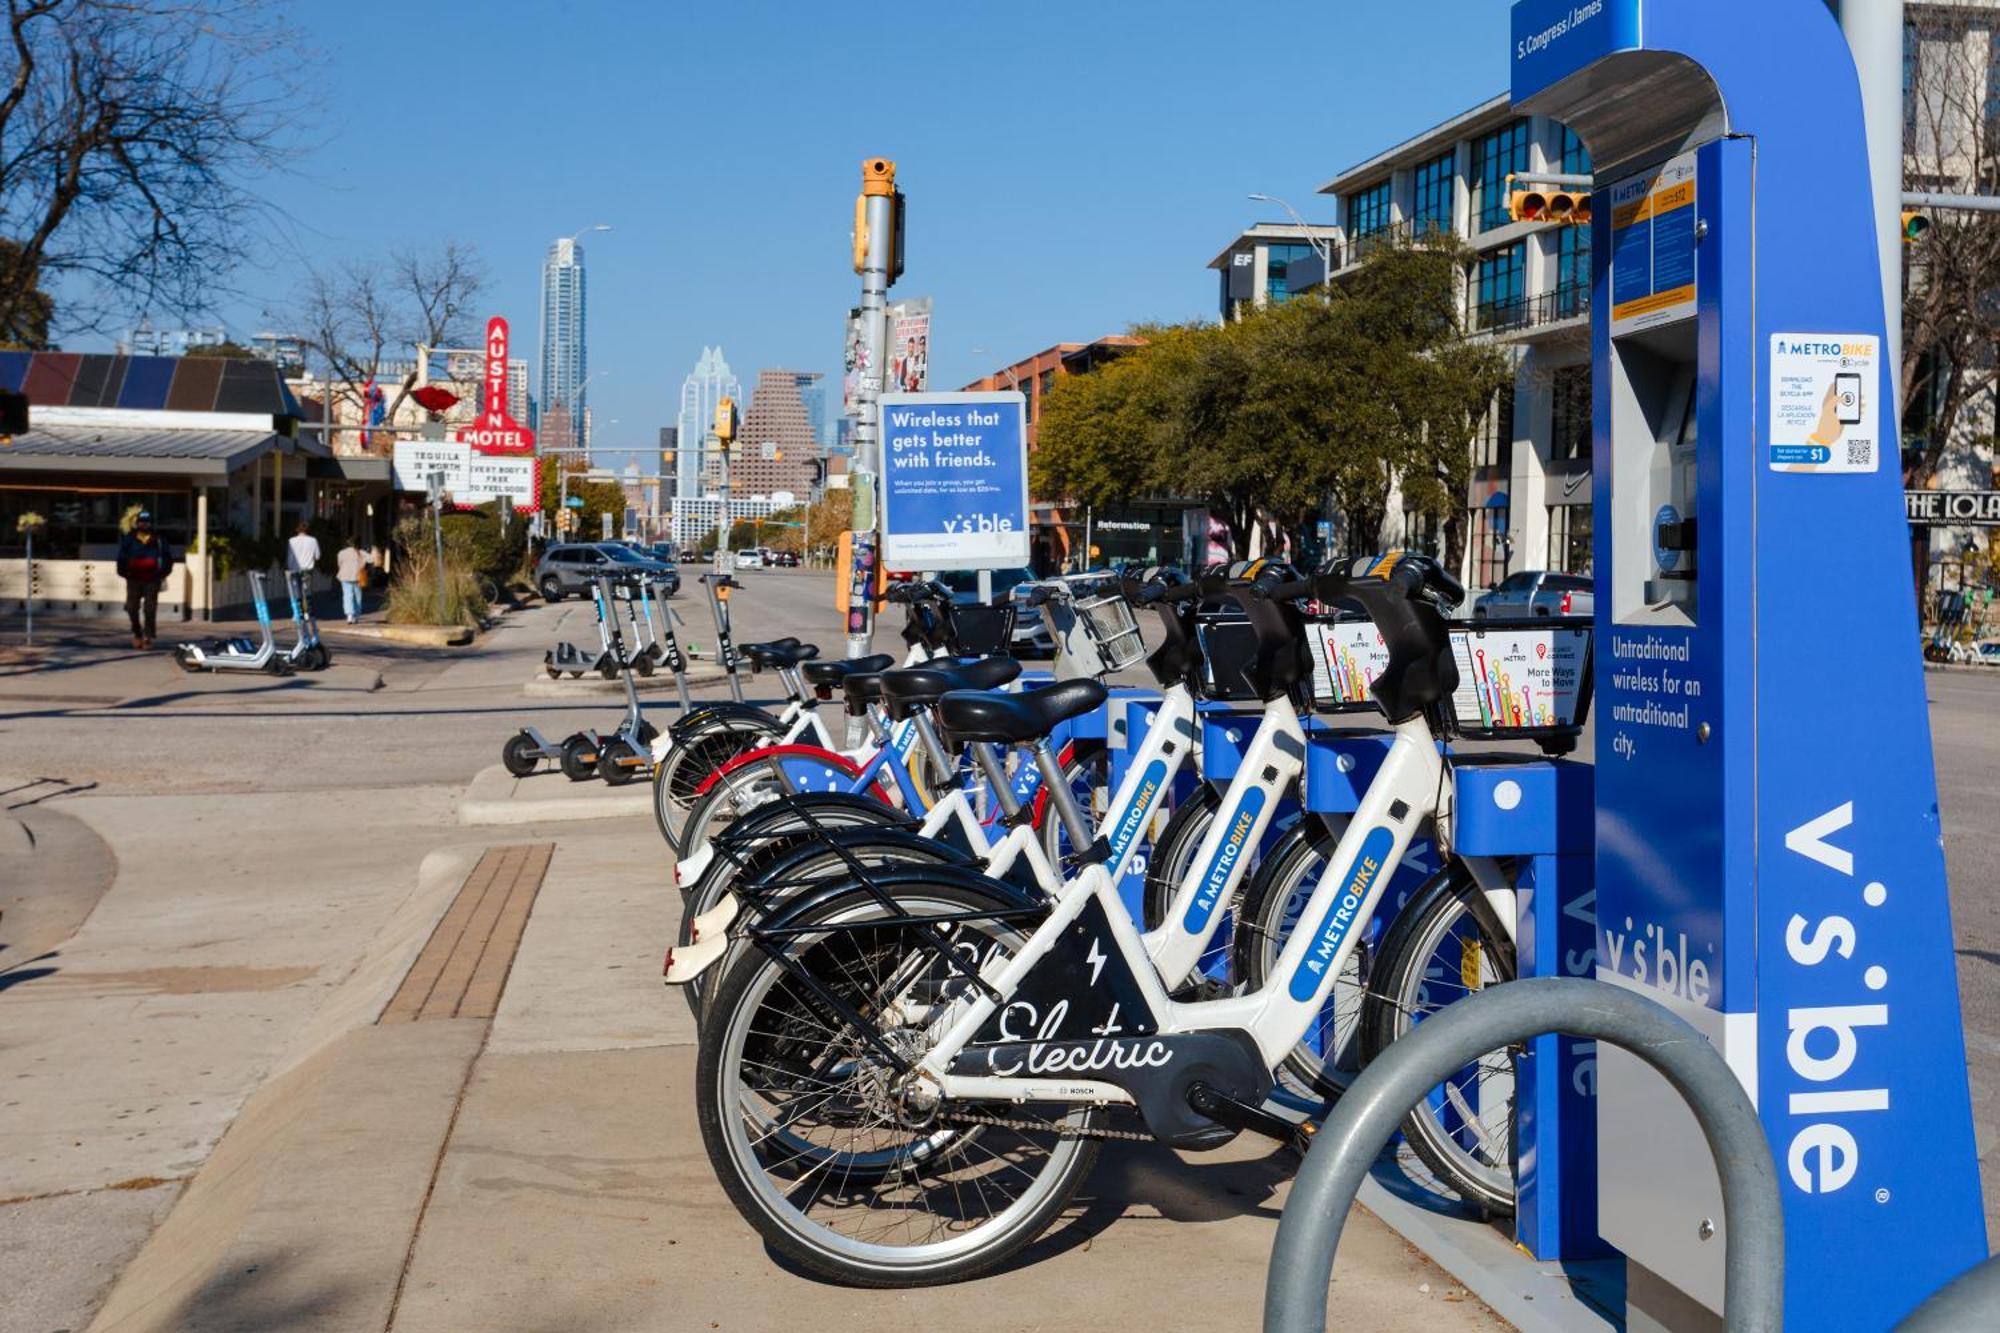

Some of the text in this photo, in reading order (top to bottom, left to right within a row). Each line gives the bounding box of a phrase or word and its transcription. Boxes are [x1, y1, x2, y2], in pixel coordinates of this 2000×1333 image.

[1526, 0, 1603, 54] Congress/James
[1233, 253, 1253, 267] EF
[1790, 343, 1873, 356] METROBIKE
[488, 325, 505, 427] AUSTIN
[892, 410, 999, 427] Wireless that
[463, 431, 525, 448] MOTEL
[892, 430, 982, 453] gets better
[414, 452, 460, 461] TEQUILA
[428, 462, 461, 471] WORTH
[893, 450, 996, 468] with friends.
[1810, 448, 1824, 461] $1
[1097, 520, 1152, 531] Reformation
[667, 639, 679, 667] BIRD
[723, 640, 735, 667] BIRD
[1613, 635, 1689, 662] Untraditional
[1527, 668, 1551, 677] More
[1541, 679, 1550, 688] to
[1613, 667, 1700, 696] wireless for an
[1613, 700, 1689, 730] untraditional
[1613, 731, 1636, 761] city.
[1114, 780, 1157, 855] METROBIKE
[1205, 811, 1253, 898] METROBIKE
[1317, 855, 1379, 960] METROBIKE
[988, 1000, 1174, 1077] Electric
